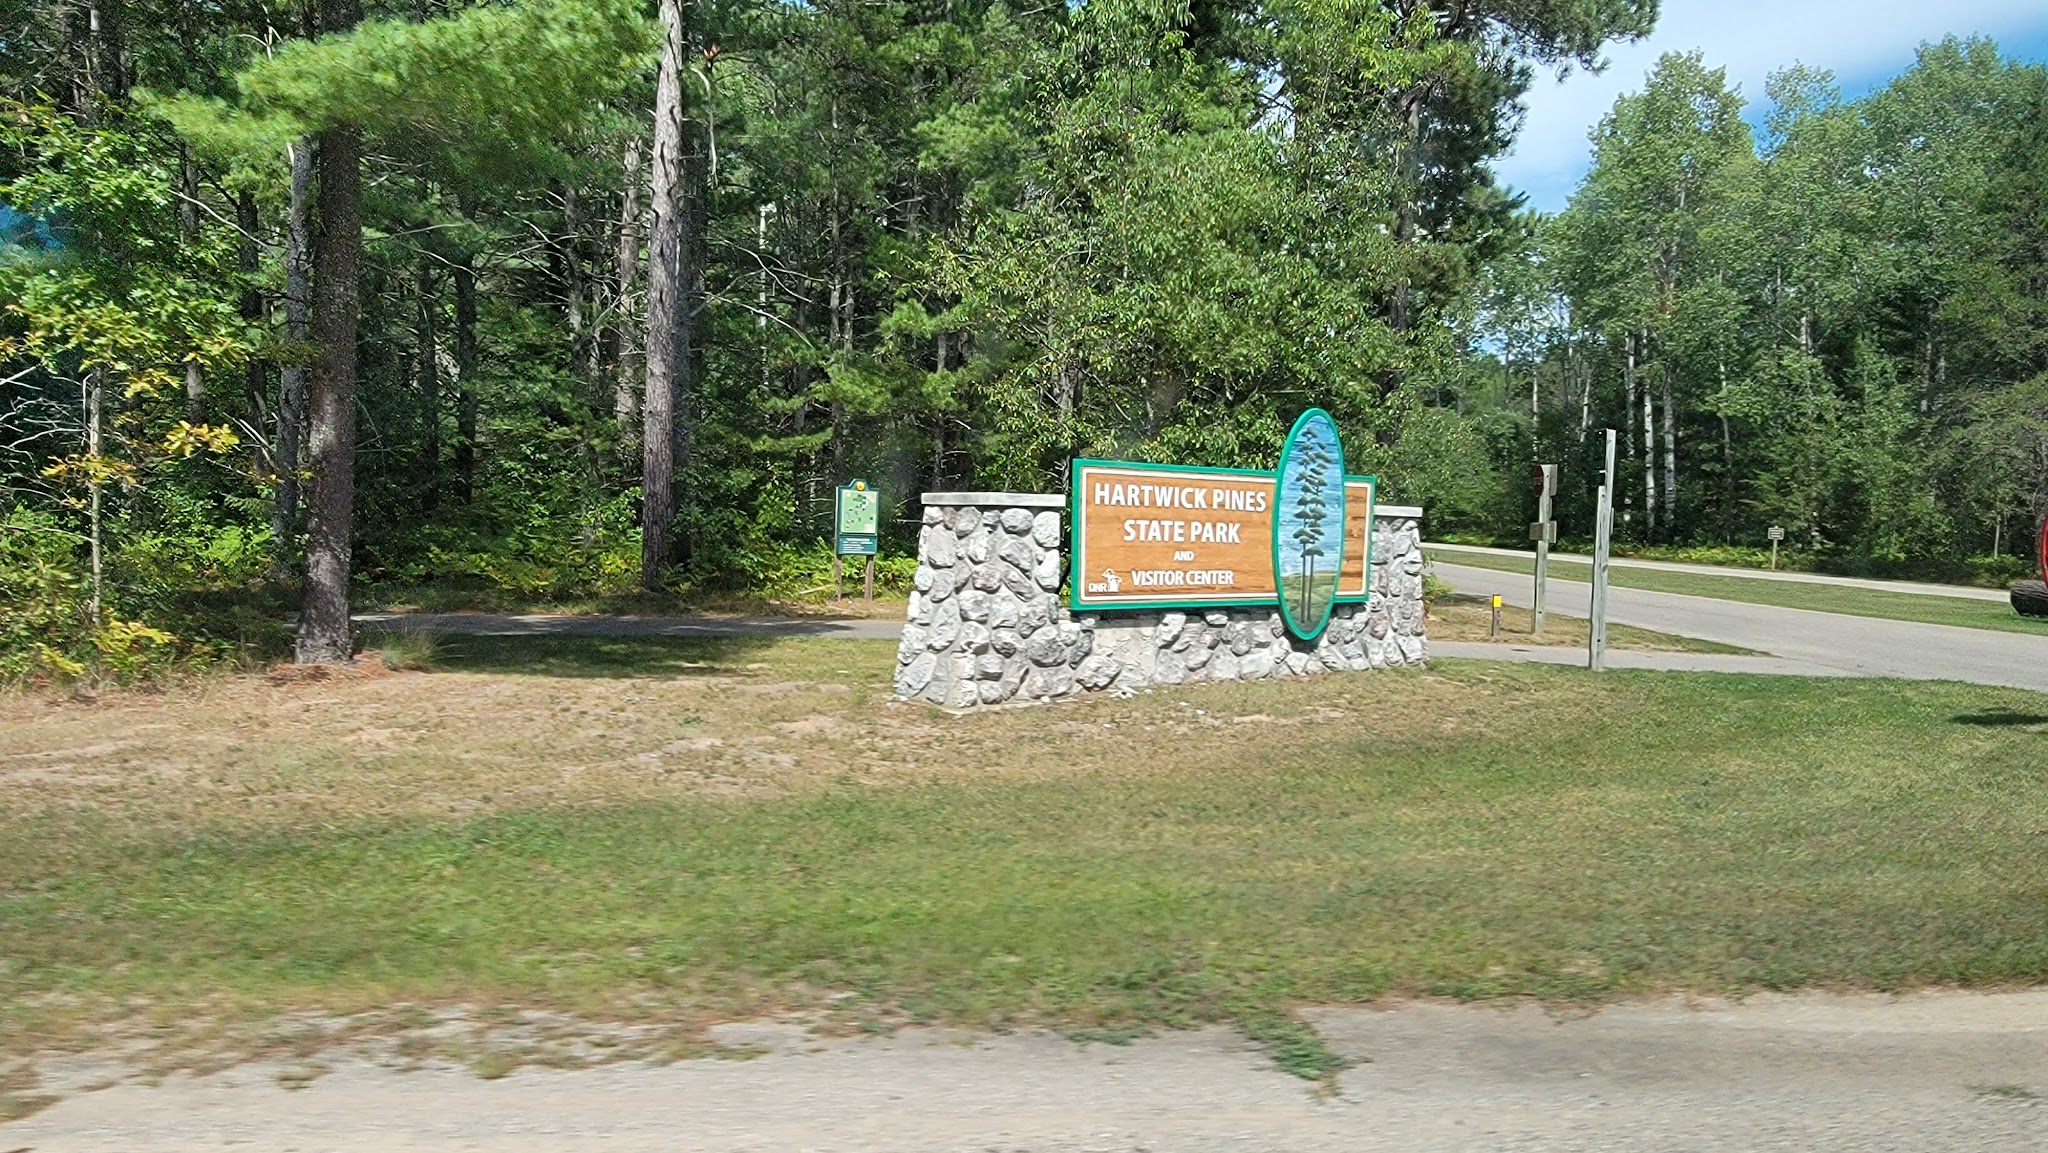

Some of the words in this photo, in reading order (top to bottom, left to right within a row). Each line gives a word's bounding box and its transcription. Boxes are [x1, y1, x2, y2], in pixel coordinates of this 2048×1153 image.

[1094, 482, 1208, 509] HARTWICK
[1213, 488, 1267, 512] PINES
[1123, 519, 1185, 542] STATE
[1190, 522, 1240, 544] PARK
[1174, 551, 1194, 561] AND
[1131, 570, 1185, 586] VISITOR
[1186, 570, 1234, 585] CENTER
[1089, 583, 1107, 593] DNR
